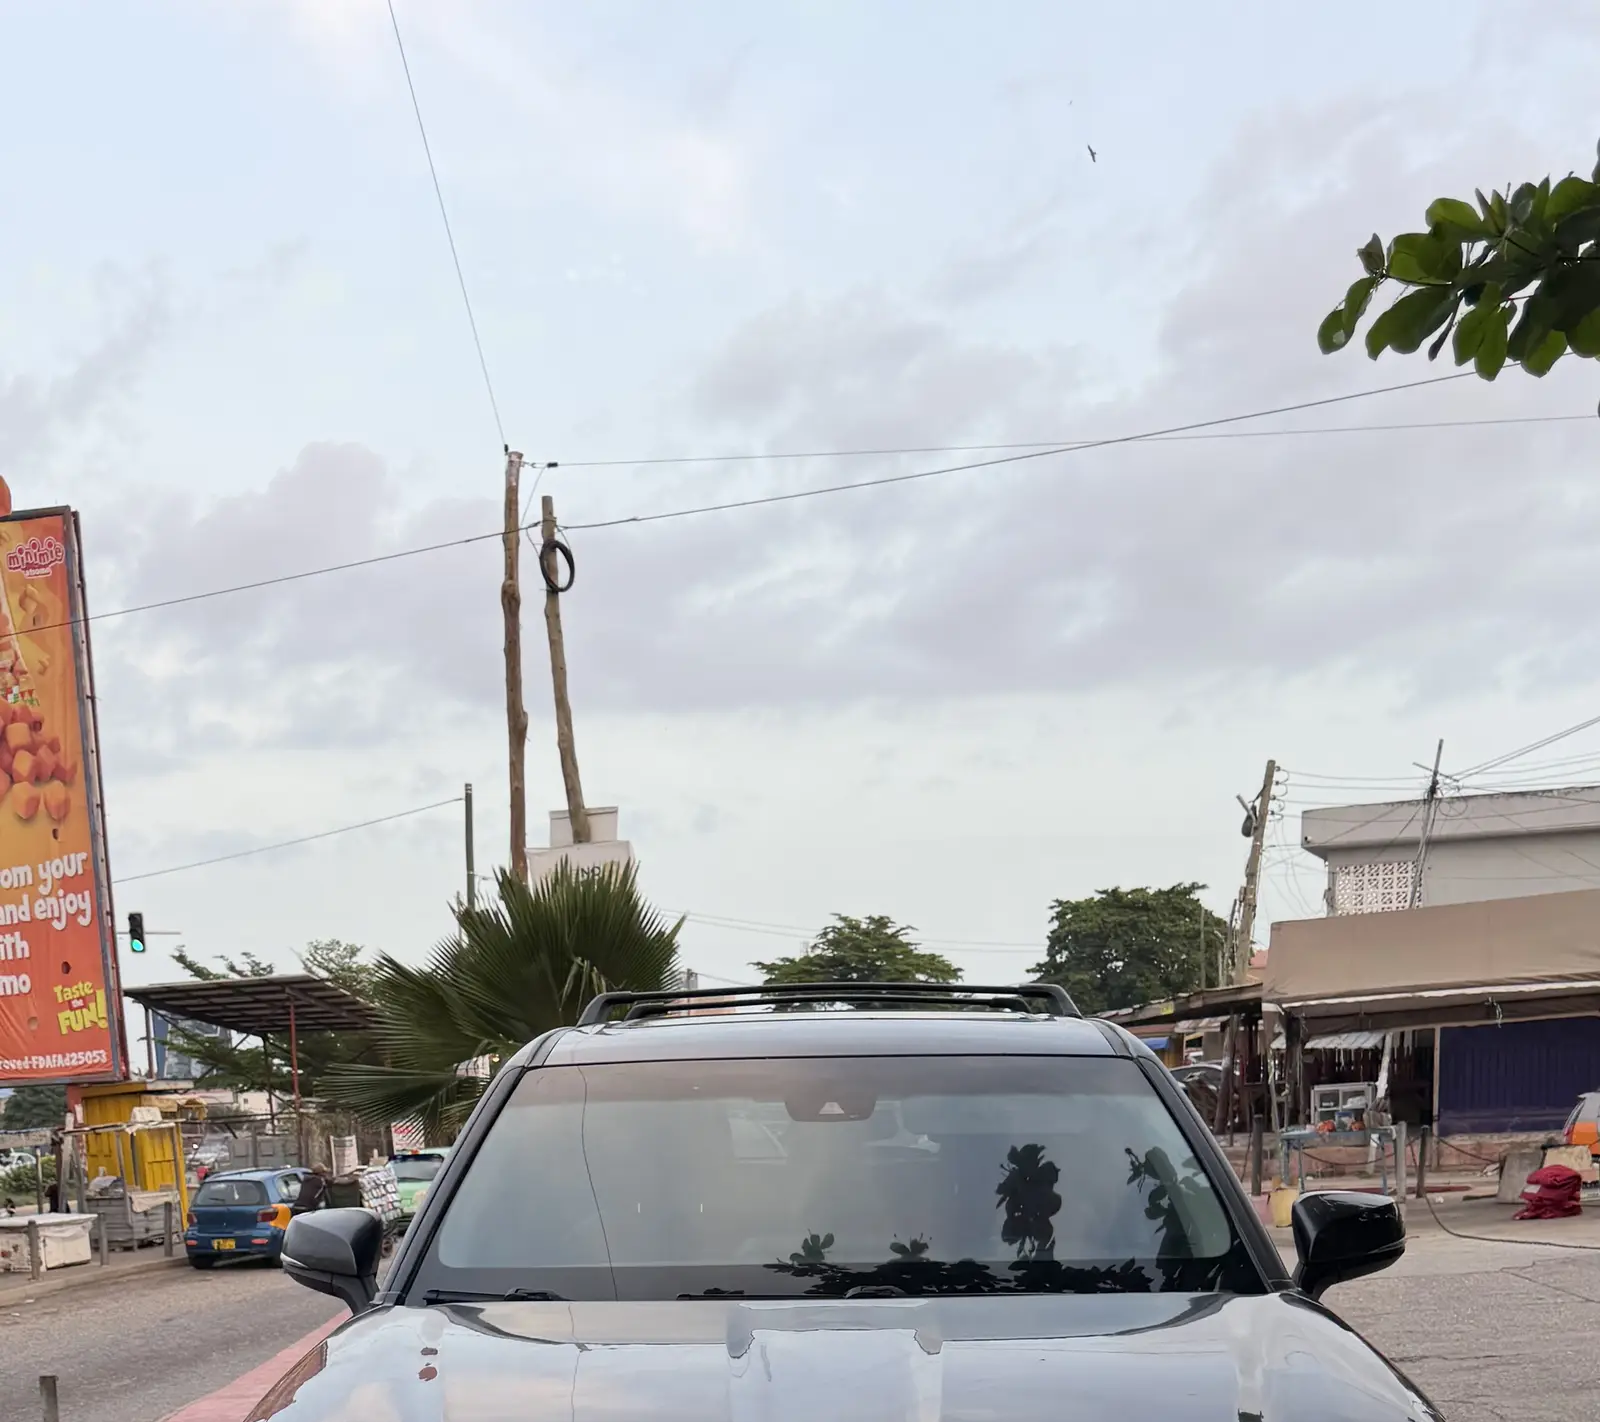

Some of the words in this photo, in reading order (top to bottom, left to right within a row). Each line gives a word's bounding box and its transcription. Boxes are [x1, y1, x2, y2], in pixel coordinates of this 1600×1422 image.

[7, 538, 63, 571] minimie
[0, 864, 33, 889] om
[38, 852, 87, 895] your
[34, 888, 91, 930] enjoy
[0, 931, 30, 961] ith
[0, 973, 31, 996] mo
[53, 981, 94, 1003] Taste
[58, 988, 109, 1035] FUN!
